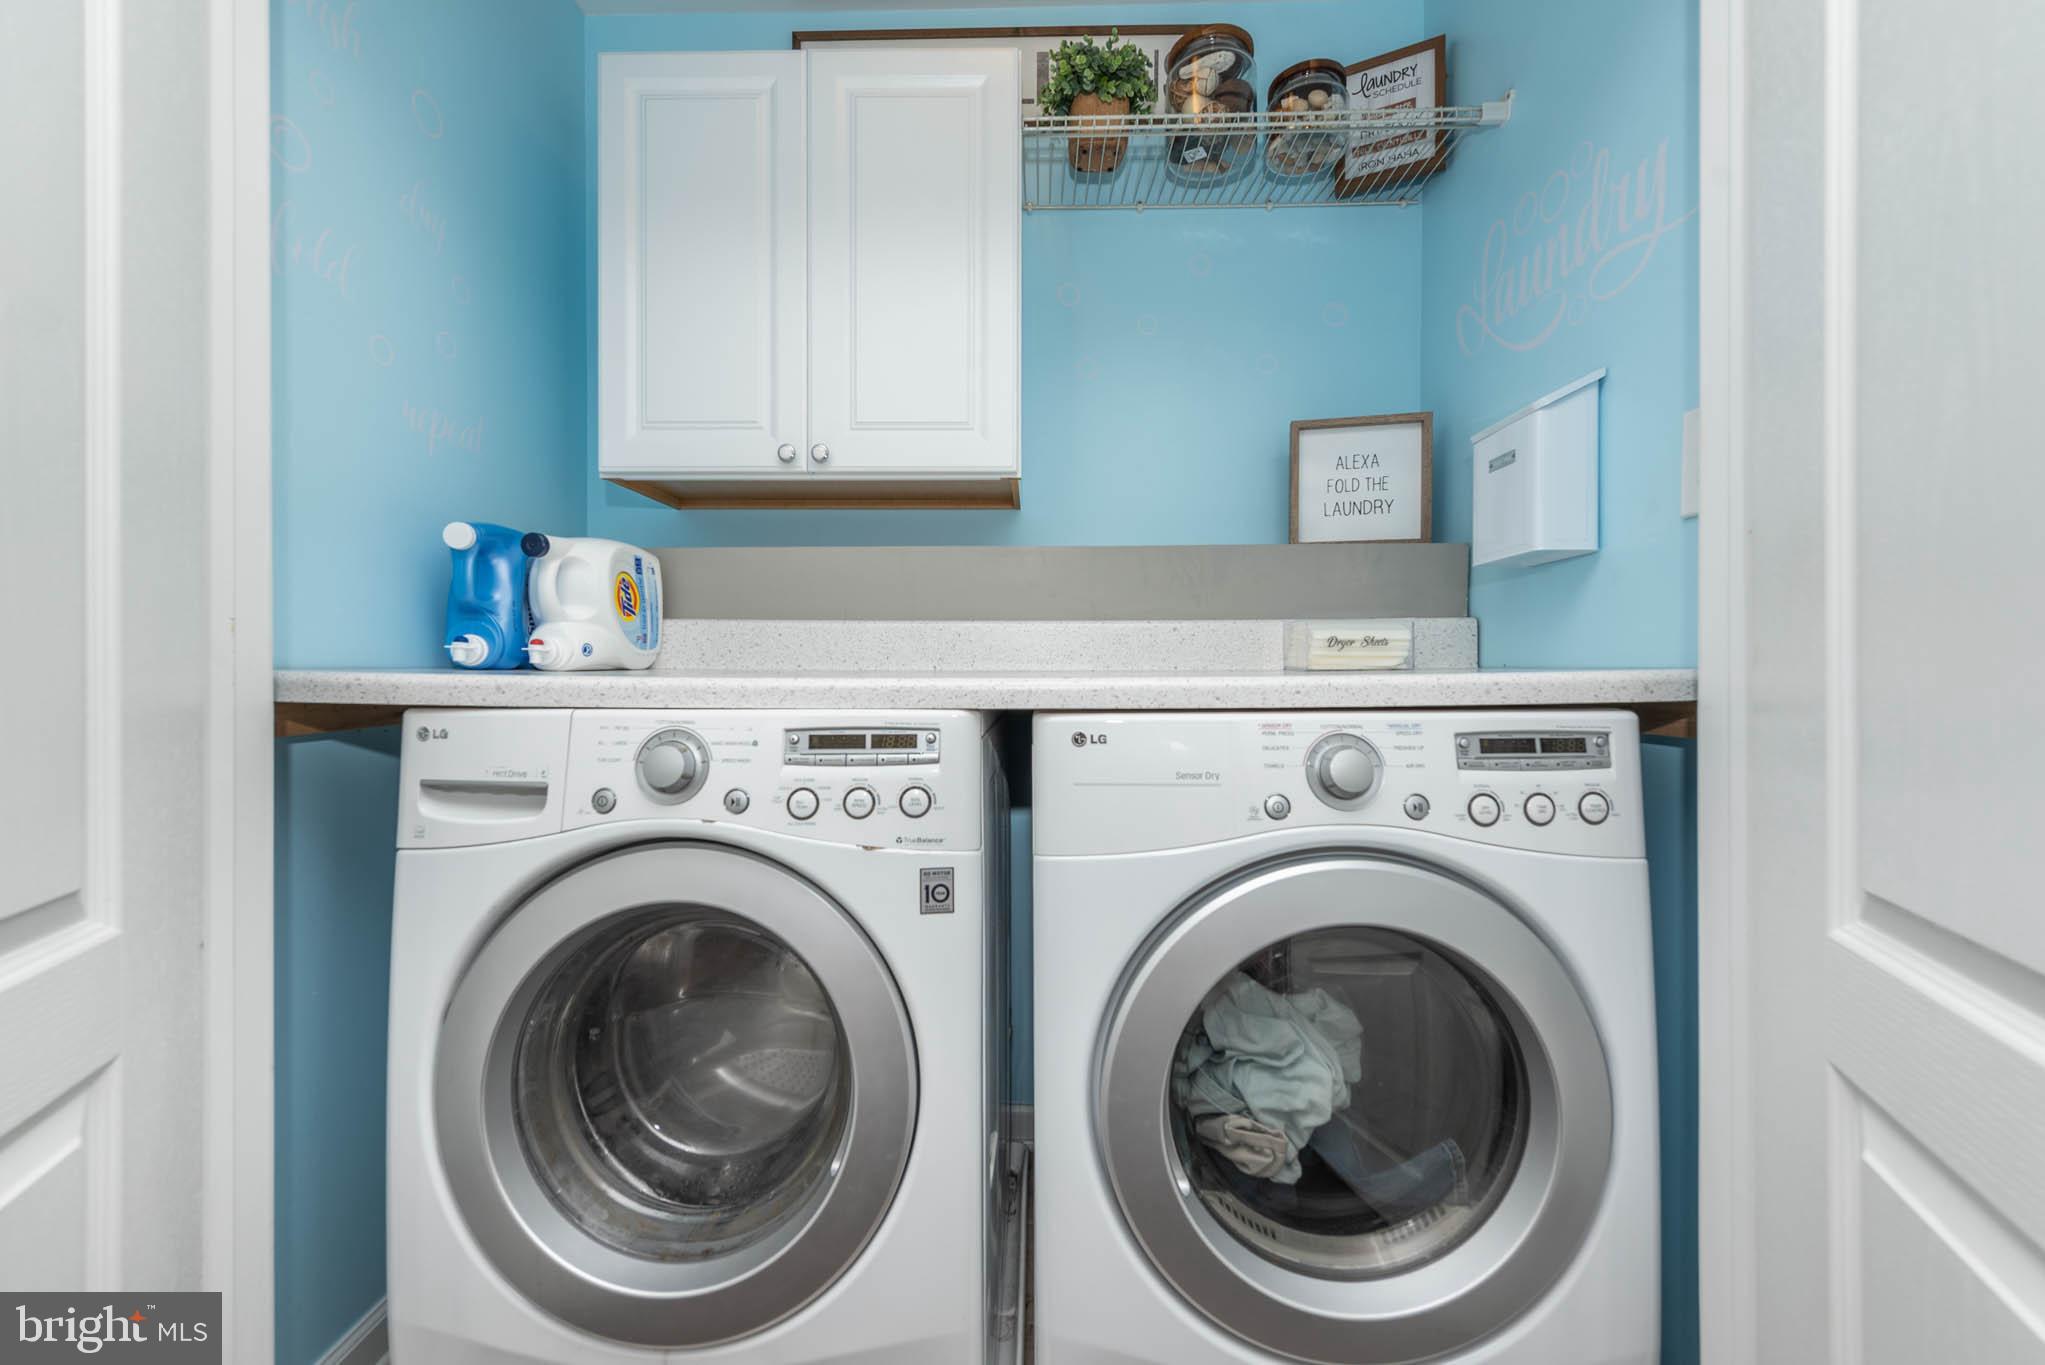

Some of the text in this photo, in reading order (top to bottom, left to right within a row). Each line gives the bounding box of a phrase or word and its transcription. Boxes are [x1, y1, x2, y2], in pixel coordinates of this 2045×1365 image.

[1372, 77, 1422, 99] SCHEDULE
[1335, 453, 1380, 471] ALEXA
[1326, 475, 1389, 494] FOLD THE
[1323, 499, 1395, 518] LAUNDRY
[620, 576, 637, 617] Tide
[1327, 635, 1389, 651] Dryer Sheets
[432, 728, 449, 740] LG
[1089, 734, 1108, 745] LG
[1175, 770, 1220, 782] Sensor Dry
[924, 883, 950, 904] 10
